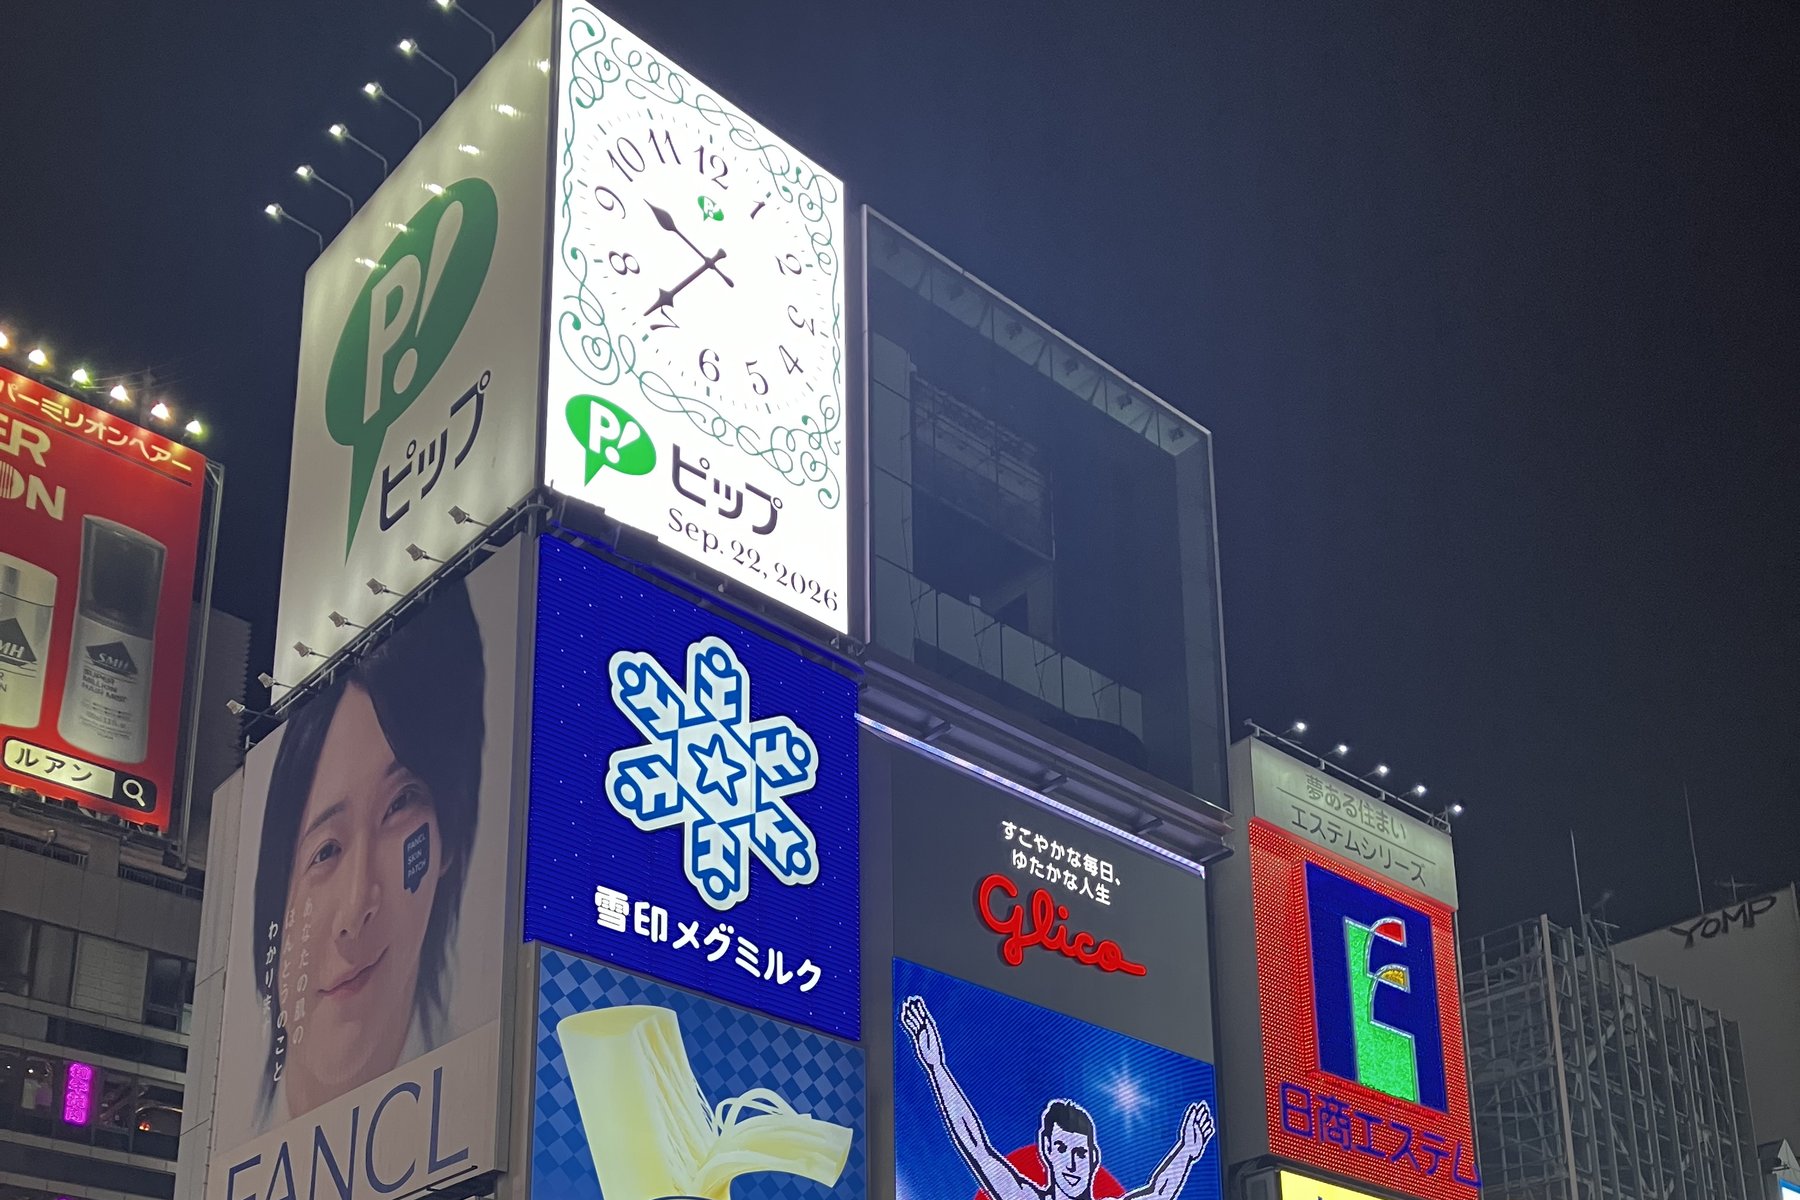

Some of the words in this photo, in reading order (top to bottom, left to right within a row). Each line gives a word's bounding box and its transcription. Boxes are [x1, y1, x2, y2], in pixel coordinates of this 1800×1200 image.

[606, 136, 646, 182] 10
[648, 128, 682, 165] 11
[694, 144, 729, 190] 12
[594, 185, 627, 220] 9
[749, 201, 766, 220] 1
[608, 250, 641, 276] 8
[774, 253, 803, 276] 2
[650, 304, 681, 331] 7
[787, 304, 815, 336] 3
[698, 348, 720, 383] 6
[745, 359, 769, 395] 5
[778, 344, 805, 375] 4
[379, 369, 492, 532] ピップ
[671, 442, 784, 536] ピップ
[667, 507, 724, 554] Sep.
[730, 538, 768, 579] 22,
[773, 562, 839, 612] 2026
[14, 747, 93, 782] ルアン
[1306, 774, 1407, 840] 夢ある住まい
[1001, 820, 1121, 885] すこやかな毎日、
[1291, 804, 1426, 887] エステムシリーズ
[1012, 849, 1111, 905] ゆたかな人生
[594, 884, 822, 992] 雪印メグミルク
[978, 873, 1147, 977] Glico
[1279, 1081, 1482, 1189] 日商エステム
